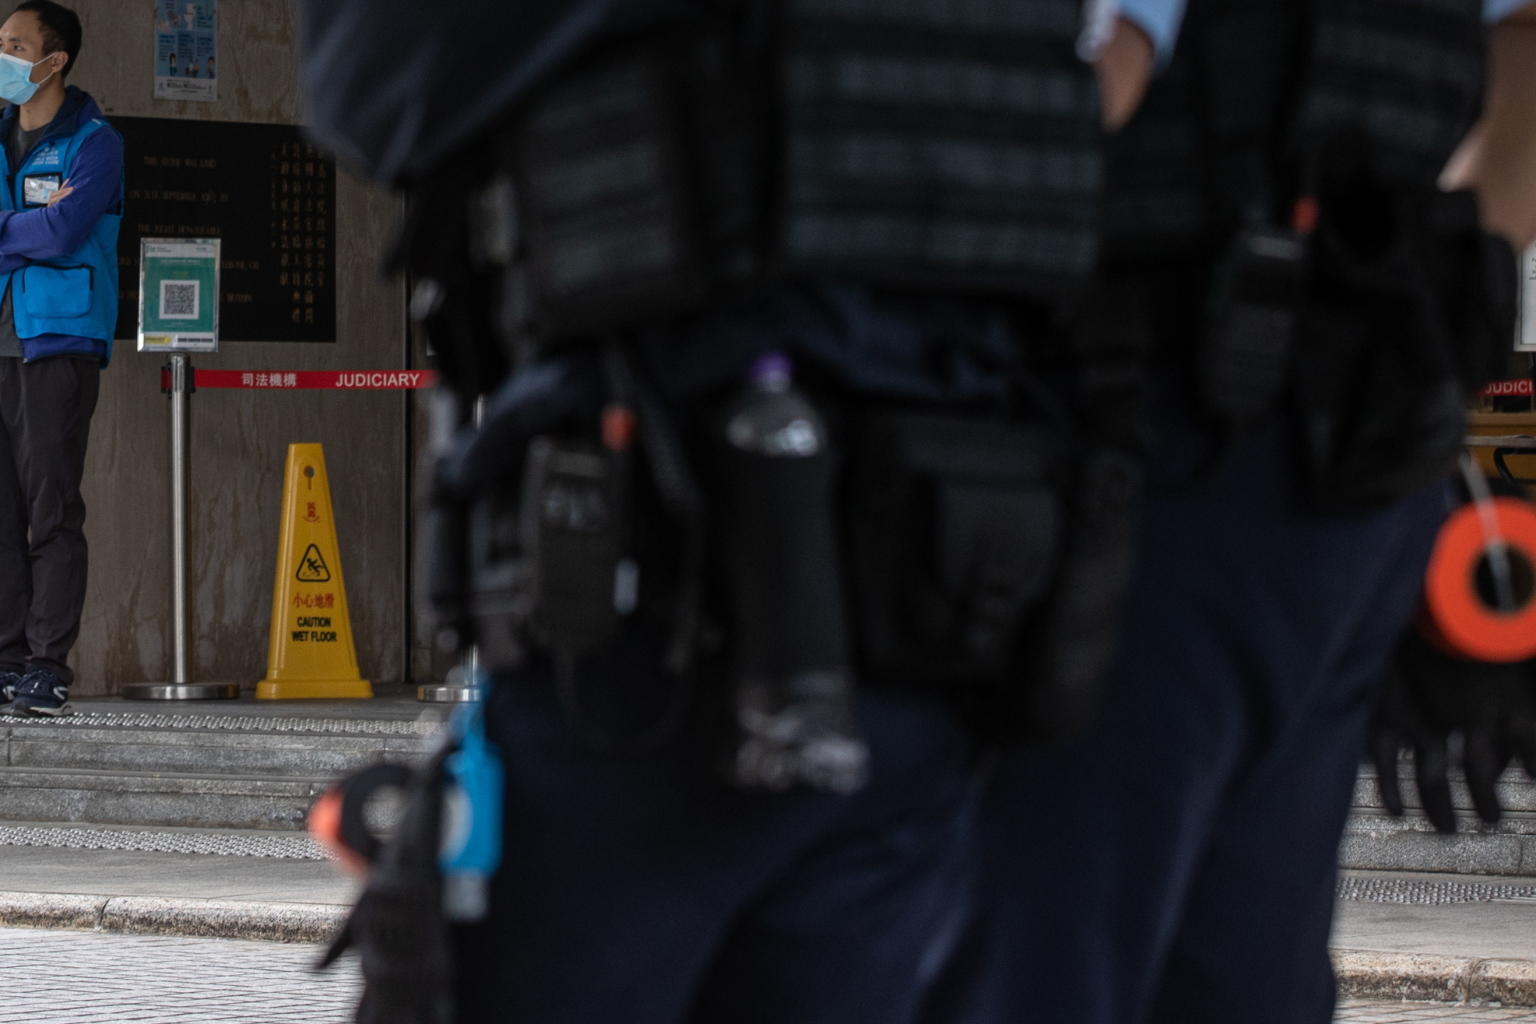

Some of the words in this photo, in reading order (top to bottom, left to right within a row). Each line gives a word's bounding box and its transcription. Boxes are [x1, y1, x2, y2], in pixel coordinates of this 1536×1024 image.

[240, 372, 297, 387] 司法機構
[335, 372, 420, 387] JUDICIARY
[292, 592, 335, 610] 小心地滑
[296, 616, 332, 628] CAUTION
[291, 630, 309, 642] WET
[311, 631, 337, 642] FLOOR
